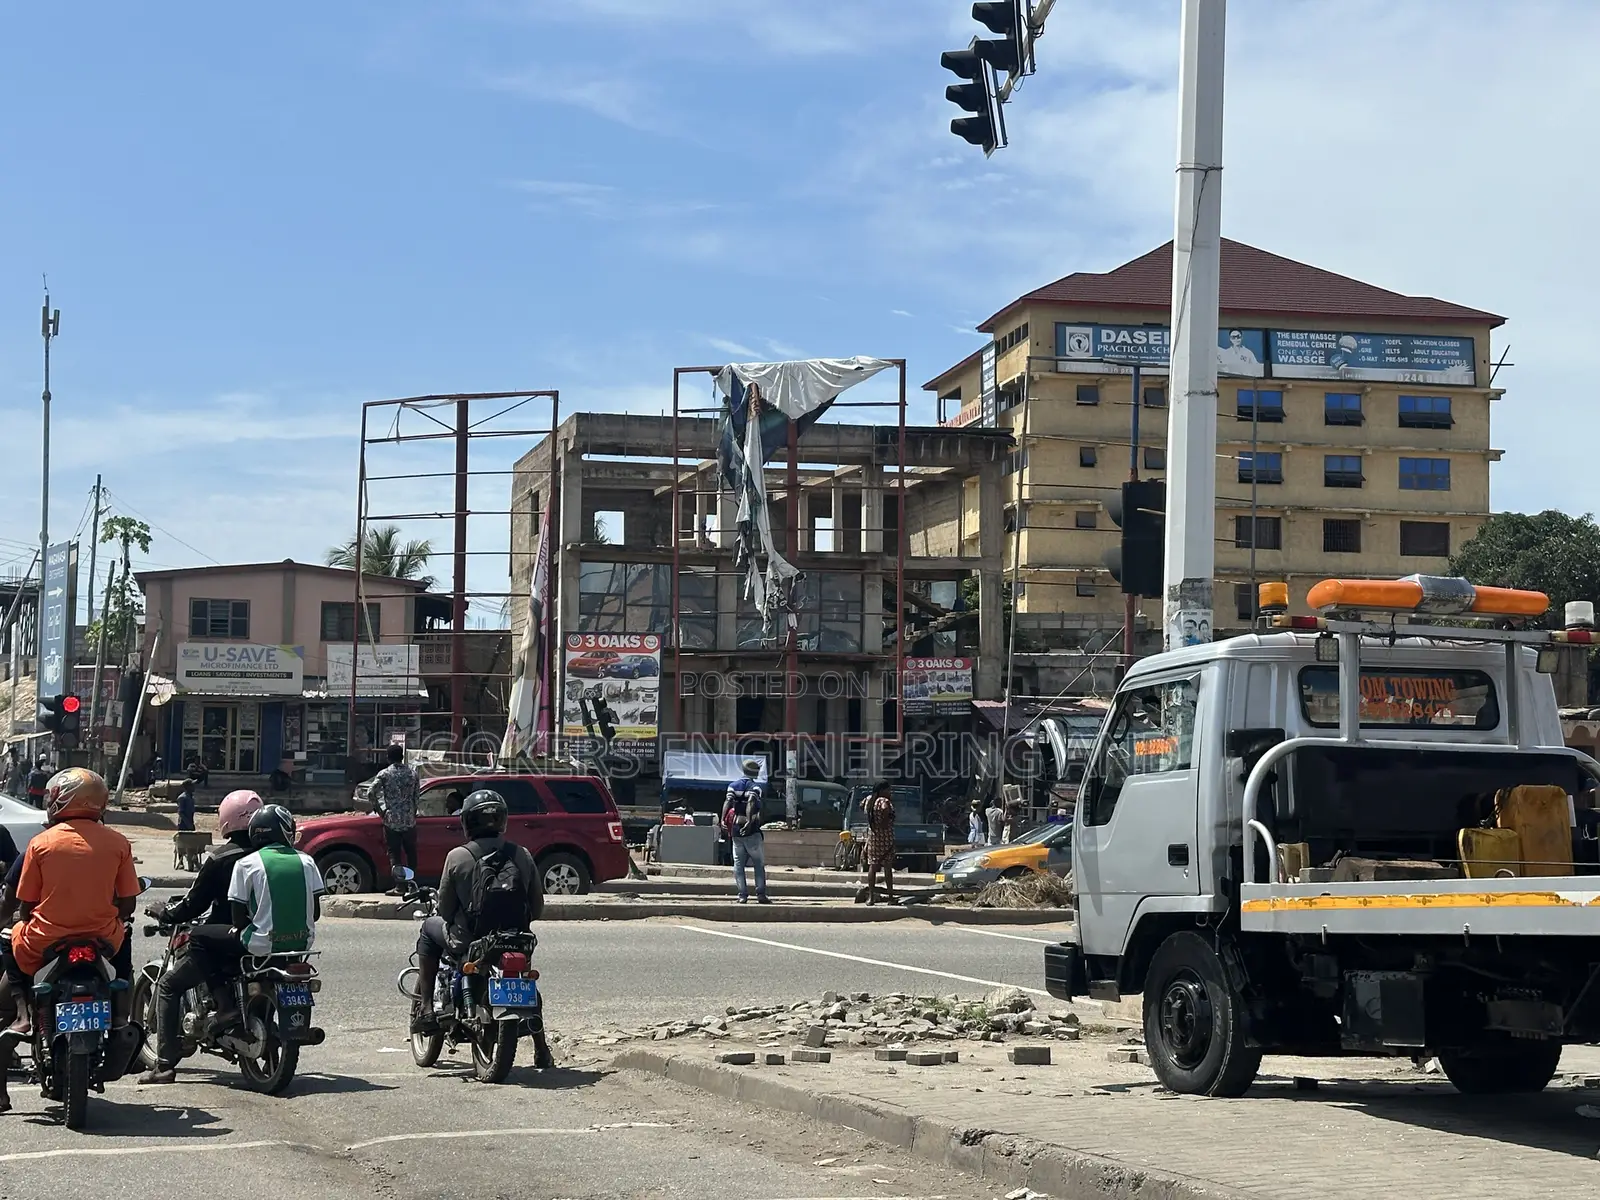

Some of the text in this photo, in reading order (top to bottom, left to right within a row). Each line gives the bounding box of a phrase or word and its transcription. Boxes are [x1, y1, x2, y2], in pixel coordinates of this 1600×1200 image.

[1291, 332, 1308, 340] BEST
[1309, 333, 1336, 341] WASSCE
[1097, 344, 1149, 354] PRACTICAL
[1277, 340, 1336, 349] REMEDIAL CENTRE
[1278, 355, 1325, 364] WASSCE
[585, 635, 641, 648] 3 OAKS
[204, 646, 277, 662] U-SAVE
[200, 662, 262, 670] MICROFINANCE
[917, 660, 953, 668] 3 OAKS
[1391, 678, 1456, 701] TOWING
[286, 995, 307, 1006] 3943
[507, 993, 523, 1003] 938
[71, 1017, 99, 1031] 2418
